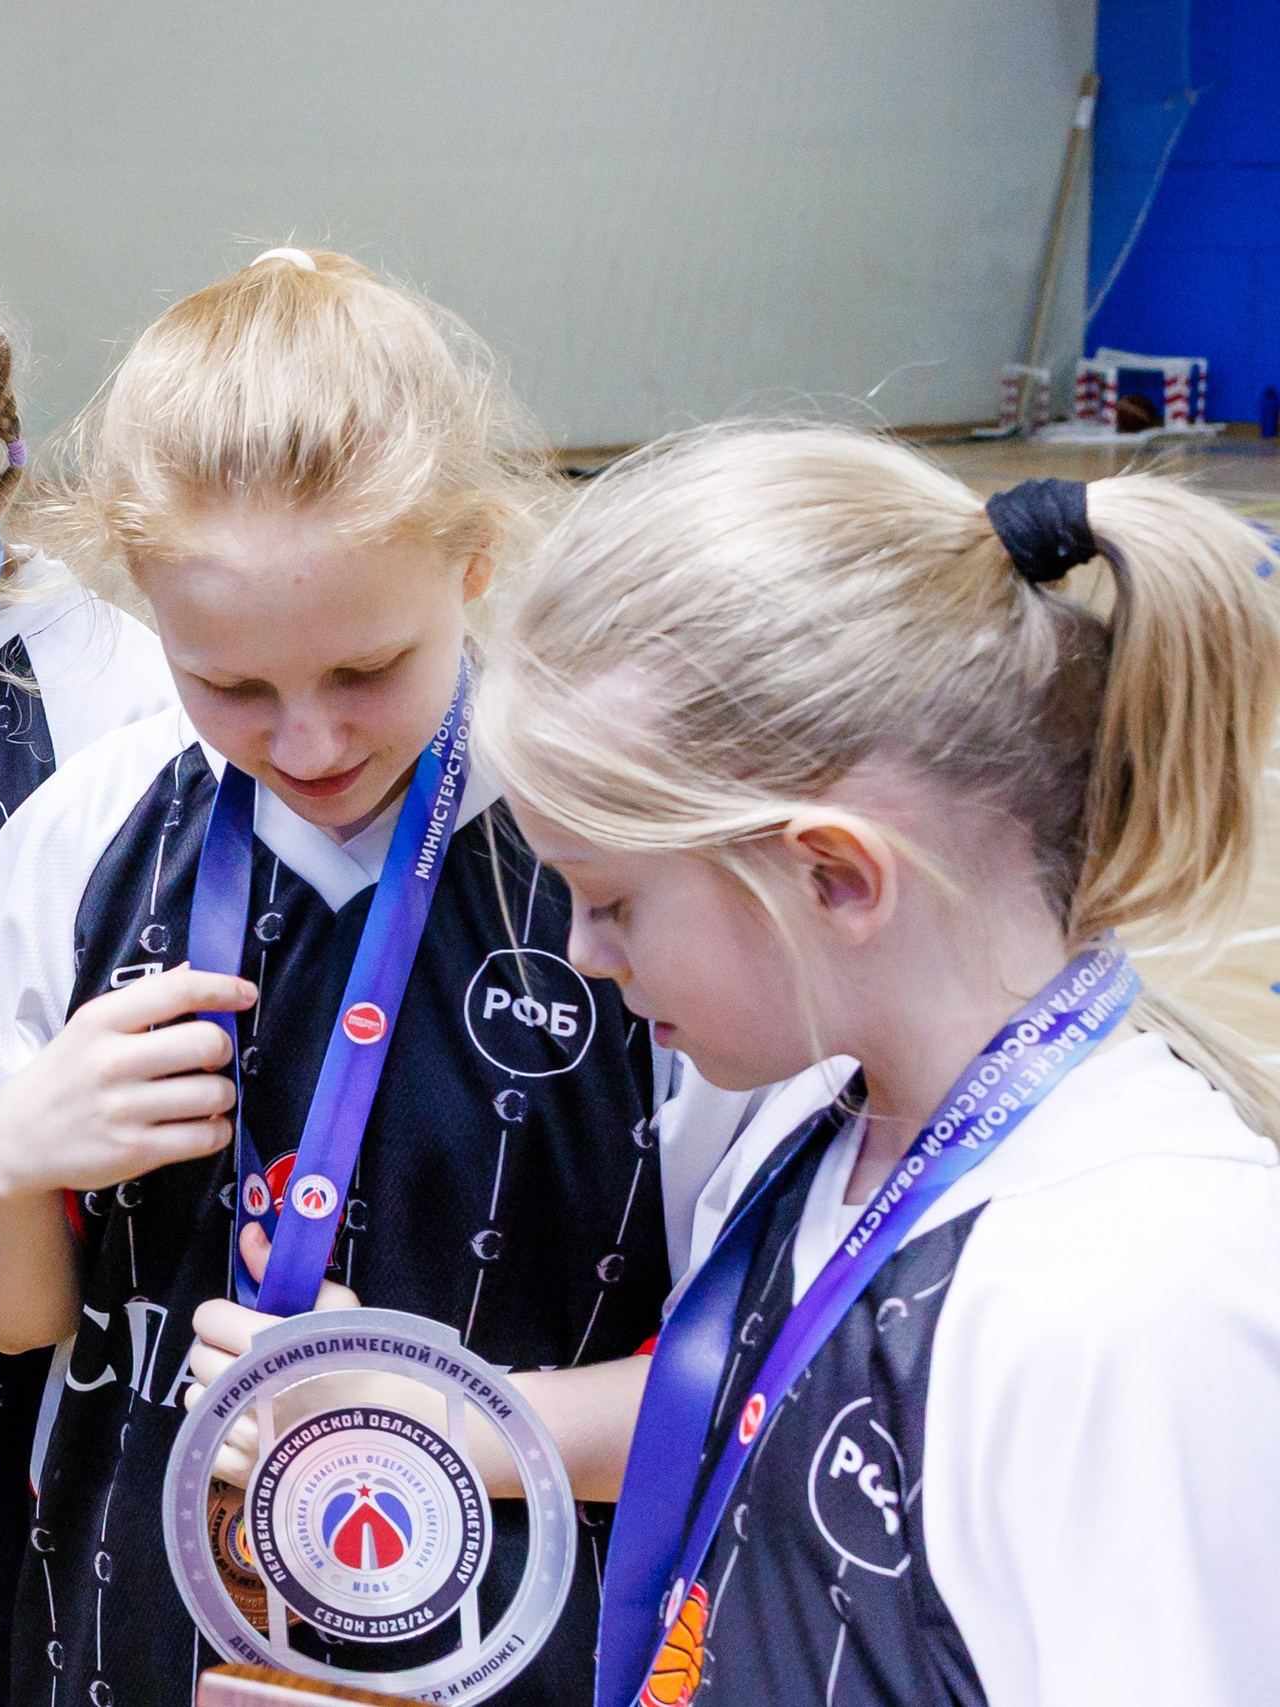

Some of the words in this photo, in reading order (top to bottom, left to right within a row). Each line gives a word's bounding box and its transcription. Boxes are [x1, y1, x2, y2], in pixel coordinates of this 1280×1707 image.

[414, 725, 470, 881] МИНИСТЕРСТВО
[483, 986, 578, 1038] РФБ
[921, 1007, 1056, 1158] МОСКОВСКОЙ
[958, 1022, 1088, 1151] БАСКЕТБОЛА
[844, 1156, 925, 1258] ОБЛАСТИ
[213, 1369, 264, 1418] ИГРОК
[263, 1337, 431, 1374] СИМВОЛИЧЕСКОЙ
[435, 1356, 513, 1419] ПЯТЕРКИ
[268, 1411, 364, 1476] МОСКОВСКОЙ
[369, 1414, 443, 1455] ОБЛАСТИ
[439, 1451, 461, 1475] ПО
[256, 1476, 287, 1583] ПЕРВЕНСТВО
[304, 1454, 359, 1494] ОБЛАСТНАЯ
[365, 1454, 427, 1495] ФЕДЕРАЦИЯ
[415, 1500, 439, 1569] БАСКЕТБОЛА
[455, 1475, 481, 1584] БАСКЕТБОЛУ
[314, 1607, 365, 1634] СЕЗОН
[369, 1606, 434, 1634] 2025/26
[352, 1581, 390, 1593] МОФБ
[229, 1635, 272, 1668] ДЕВУ
[448, 1684, 460, 1696] И
